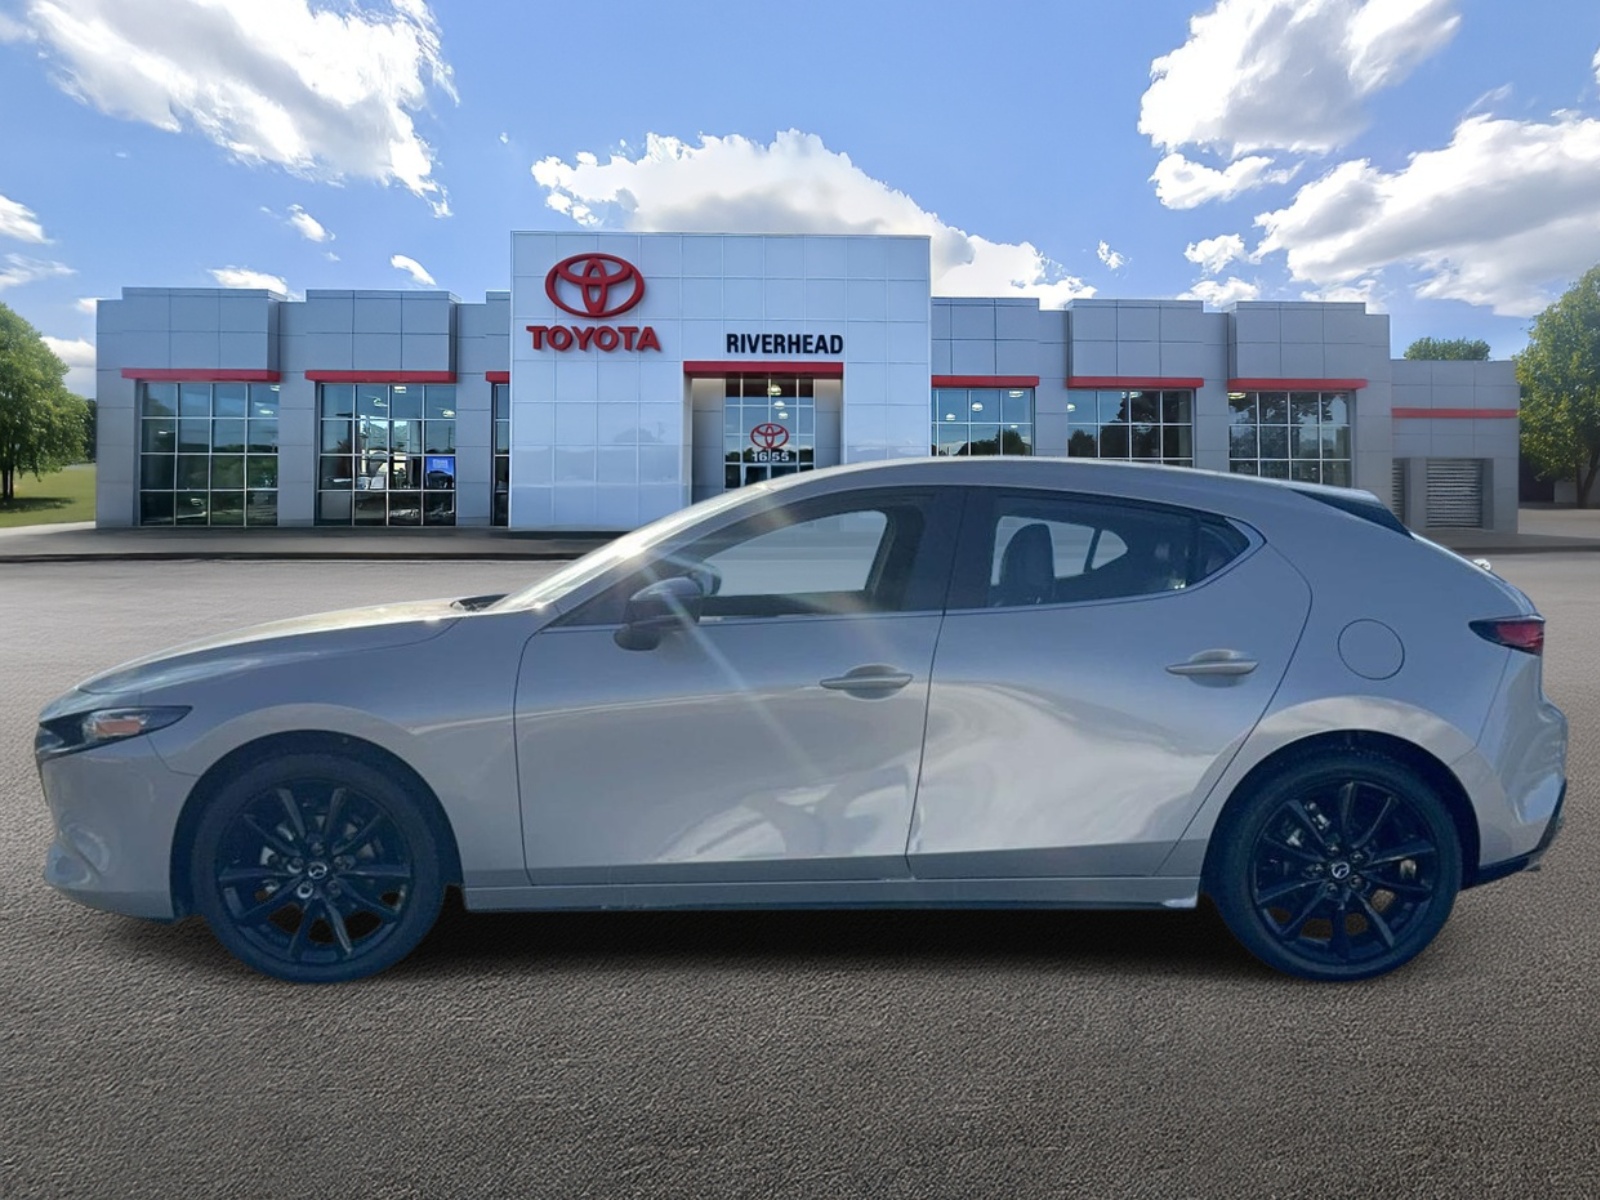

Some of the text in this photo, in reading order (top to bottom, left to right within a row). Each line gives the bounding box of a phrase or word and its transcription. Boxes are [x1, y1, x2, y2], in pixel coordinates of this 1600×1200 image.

[526, 325, 661, 352] TOYOTA
[726, 333, 843, 354] RIVERHEAD
[752, 451, 789, 462] 1655
